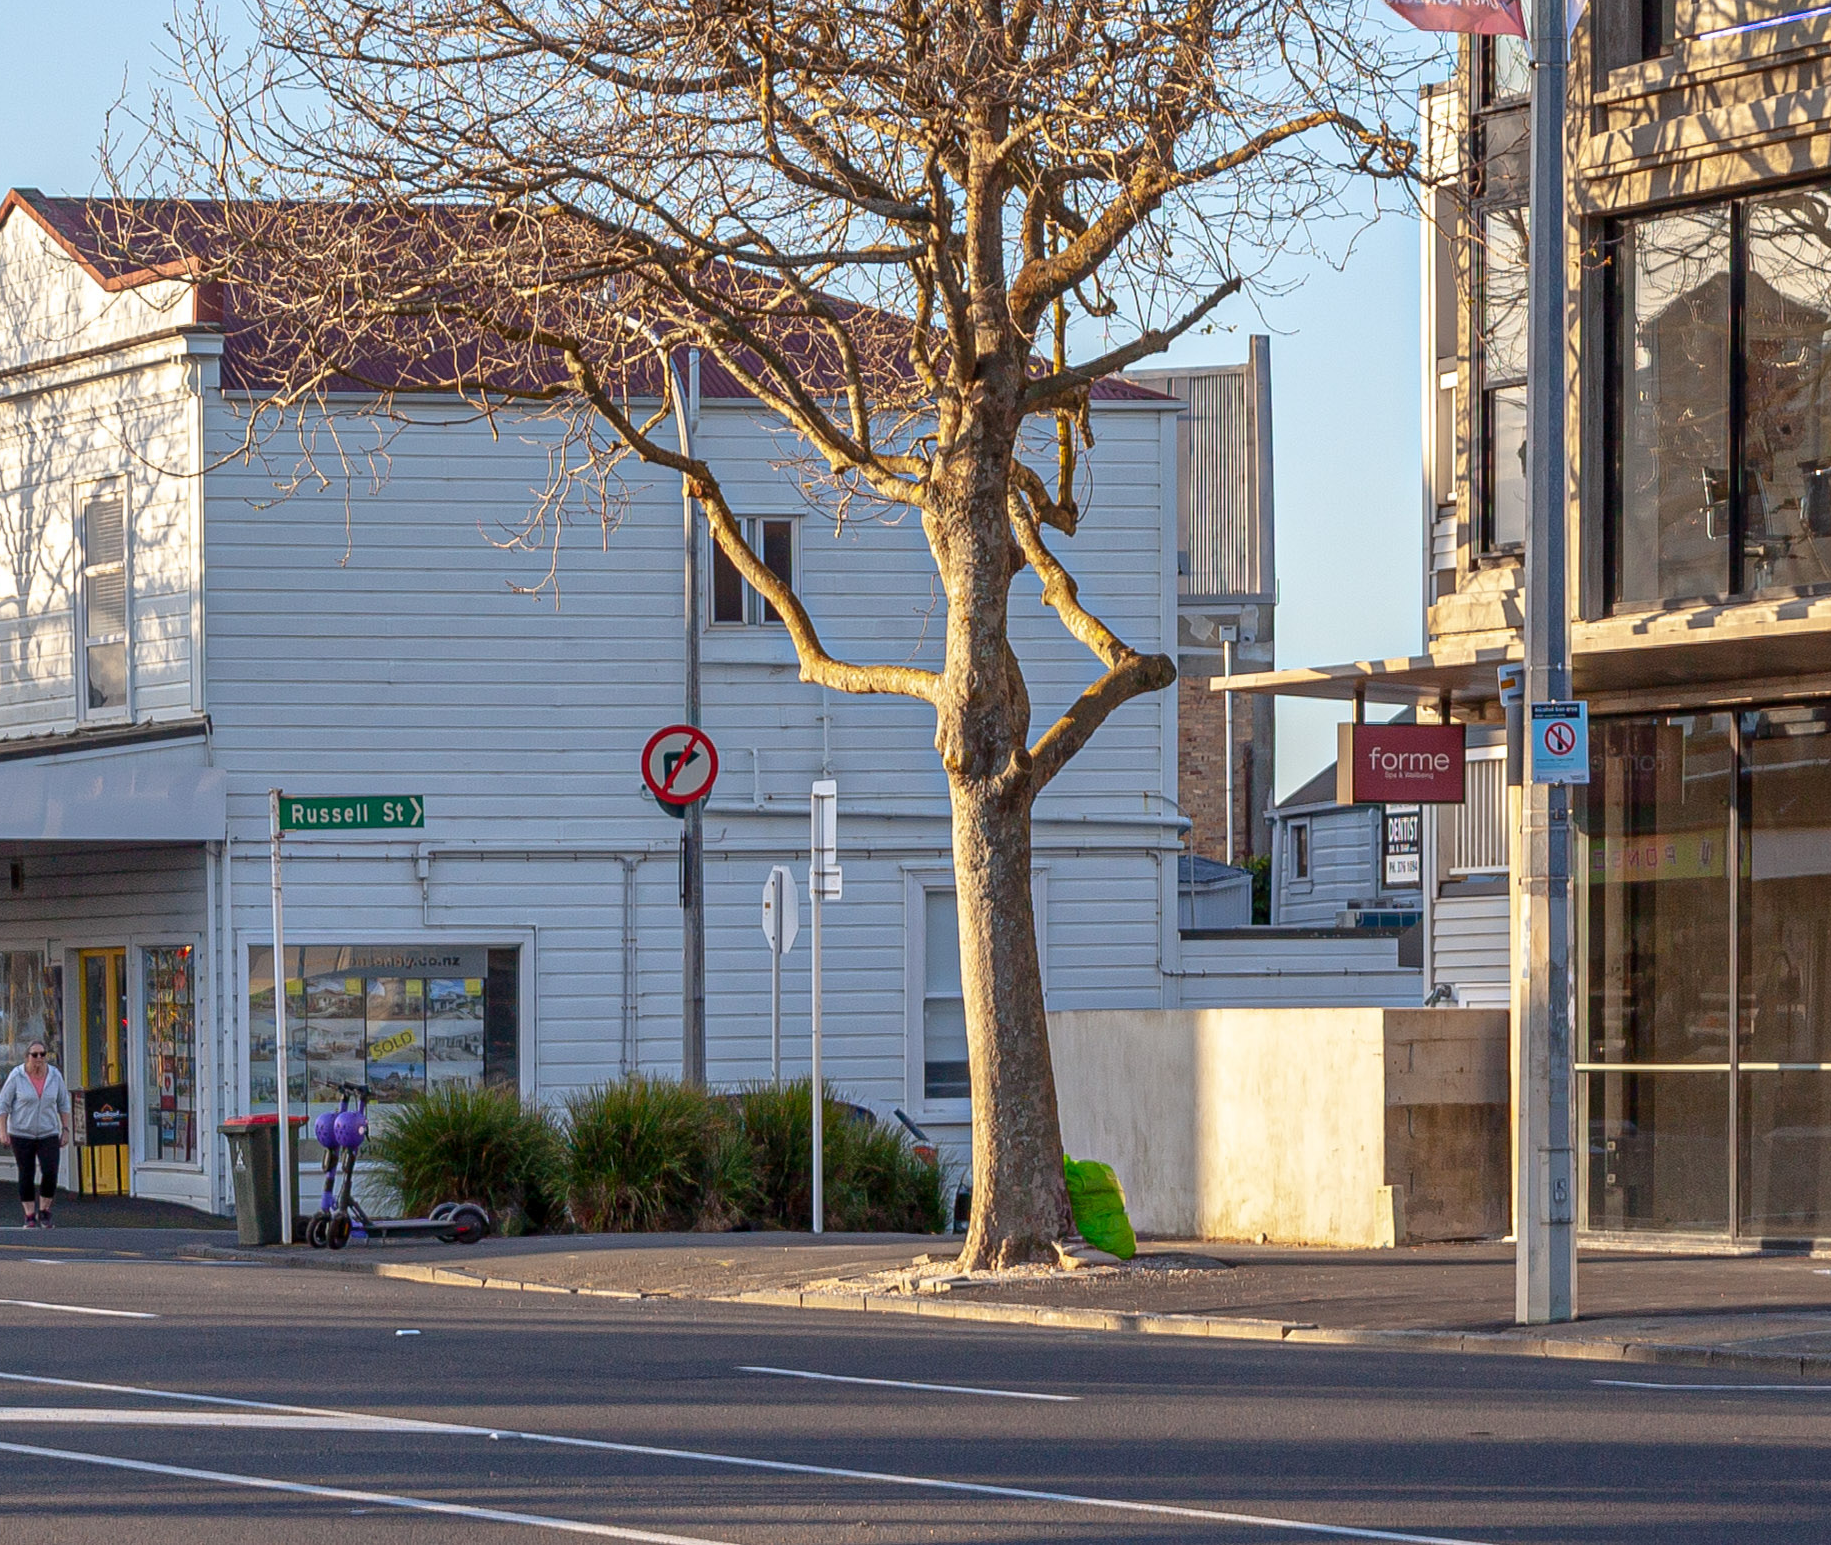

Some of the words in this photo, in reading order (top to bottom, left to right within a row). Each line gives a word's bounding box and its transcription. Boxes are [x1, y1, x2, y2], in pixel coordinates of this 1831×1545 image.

[1368, 746, 1450, 771] forme
[291, 803, 369, 825] Russell
[383, 801, 404, 823] St
[1388, 817, 1419, 843] DENTIST
[373, 1032, 413, 1059] SOLD
